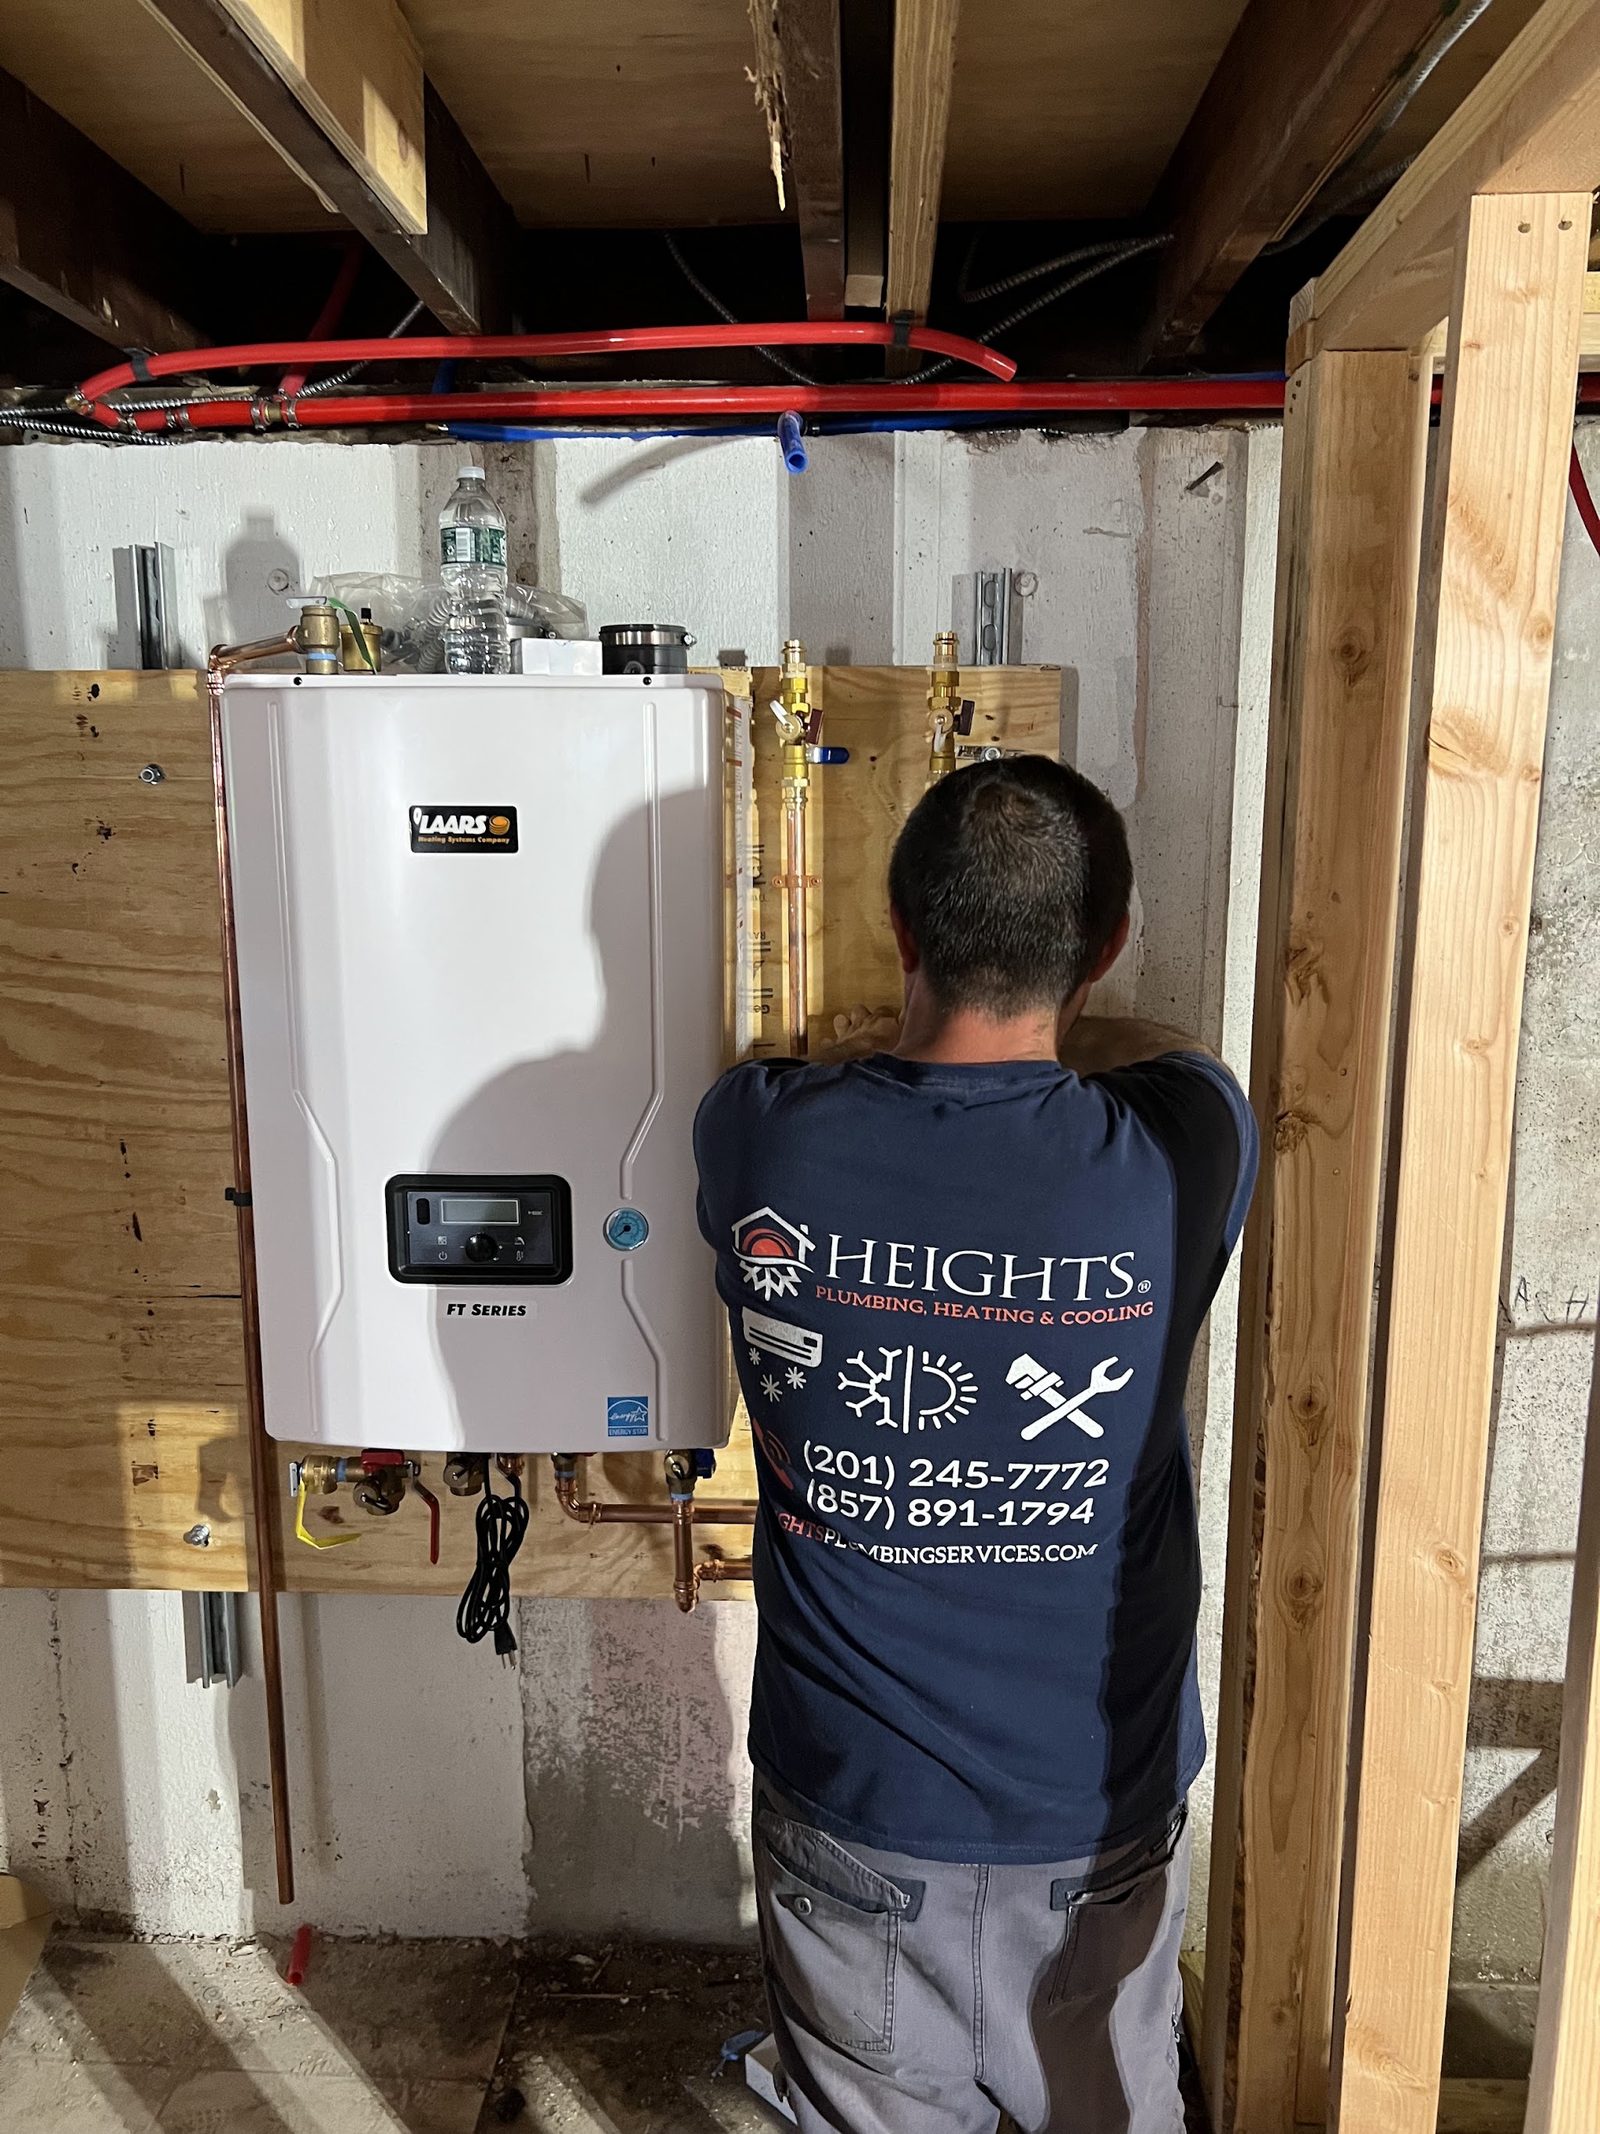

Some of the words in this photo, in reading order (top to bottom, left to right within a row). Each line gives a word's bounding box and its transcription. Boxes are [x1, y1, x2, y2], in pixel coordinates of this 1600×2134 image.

[418, 836, 447, 844] Heating
[448, 836, 476, 844] Systems
[477, 836, 510, 844] Company
[419, 815, 487, 835] LAARS
[447, 1303, 467, 1316] FT
[816, 1285, 928, 1316] PLUMBING,
[933, 1301, 1034, 1324] HEATING
[1039, 1311, 1054, 1325] &
[1061, 1301, 1153, 1325] COOLING
[803, 1439, 895, 1491] (201)
[908, 1458, 1110, 1491] 245-7772
[806, 1478, 895, 1531] (857)
[907, 1497, 1095, 1527] 891-1794
